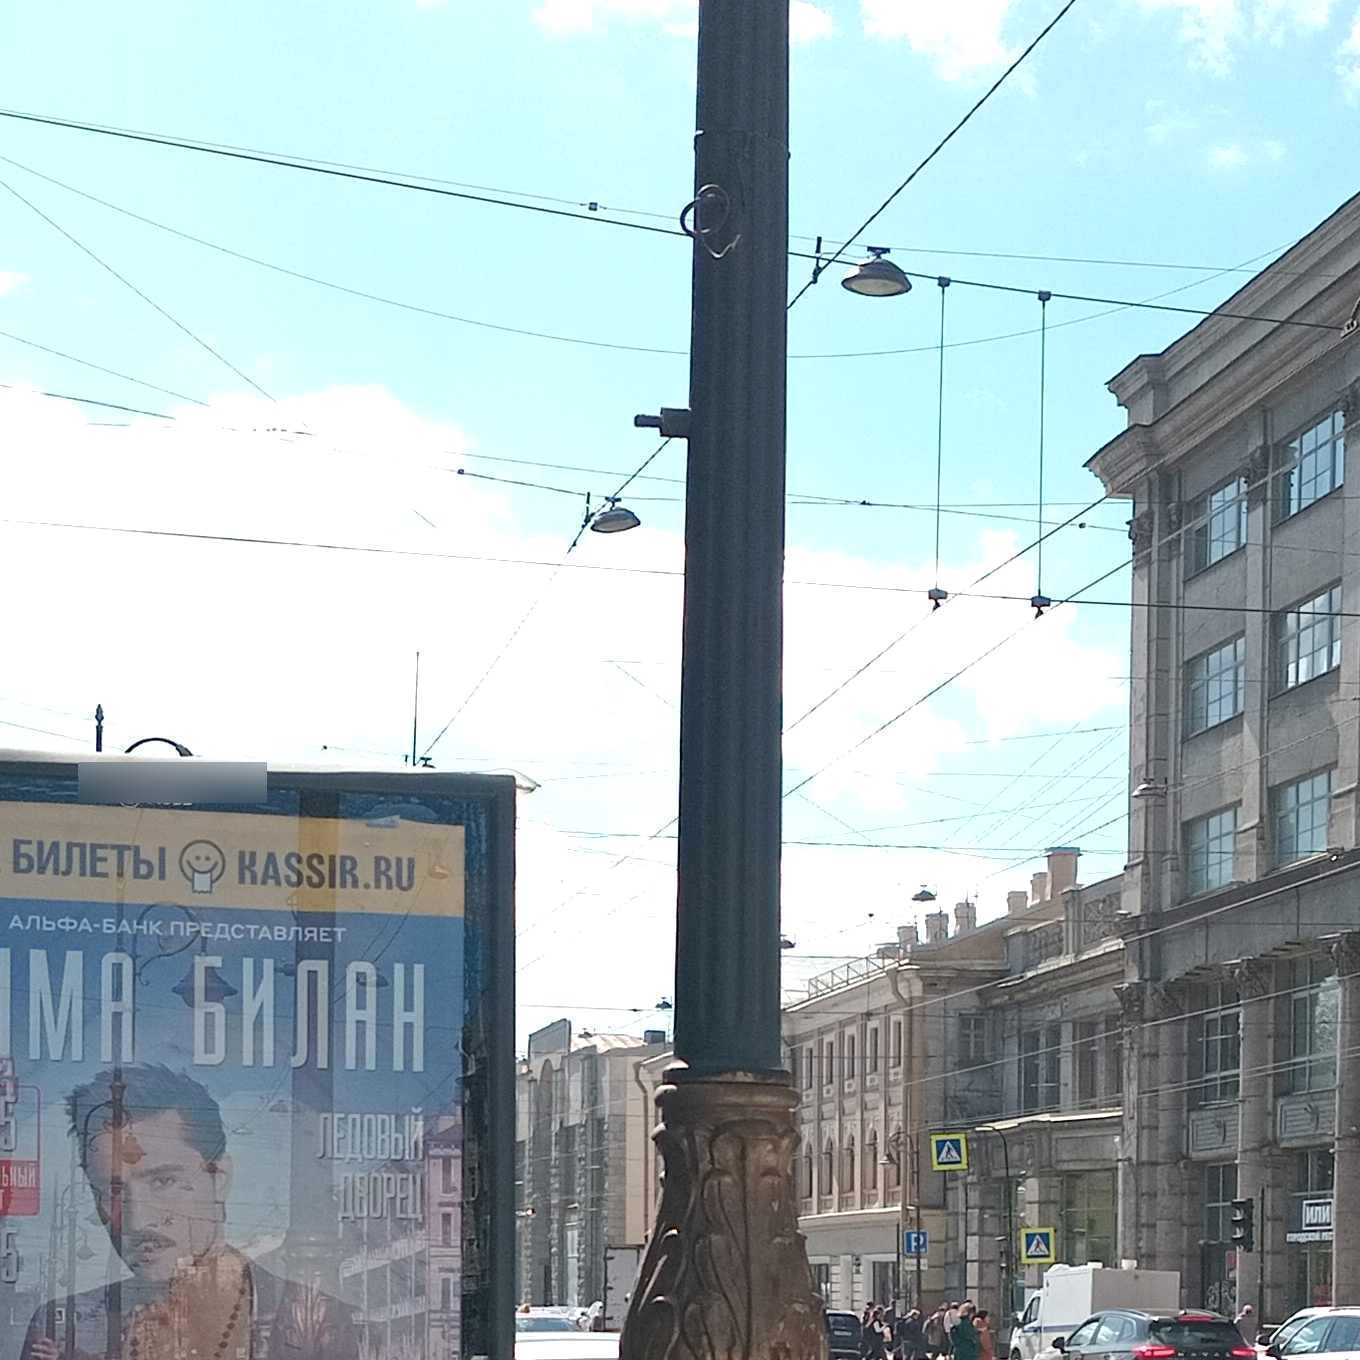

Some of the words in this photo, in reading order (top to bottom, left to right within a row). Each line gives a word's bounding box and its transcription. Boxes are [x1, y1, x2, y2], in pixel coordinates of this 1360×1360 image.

[12, 838, 166, 881] БИЛЕТЫ
[237, 850, 416, 892] KASSIR.RU
[8, 913, 163, 937] АЛЬФА-БАНК
[170, 920, 348, 943] ПРЕДСТАВЛЯЕТ
[191, 955, 425, 1073] БИЛАН
[316, 1106, 425, 1162] ЛЕДОВЫЙ
[338, 1171, 424, 1222] ДВОРЕЦ
[1305, 1205, 1331, 1224] ИЛИ
